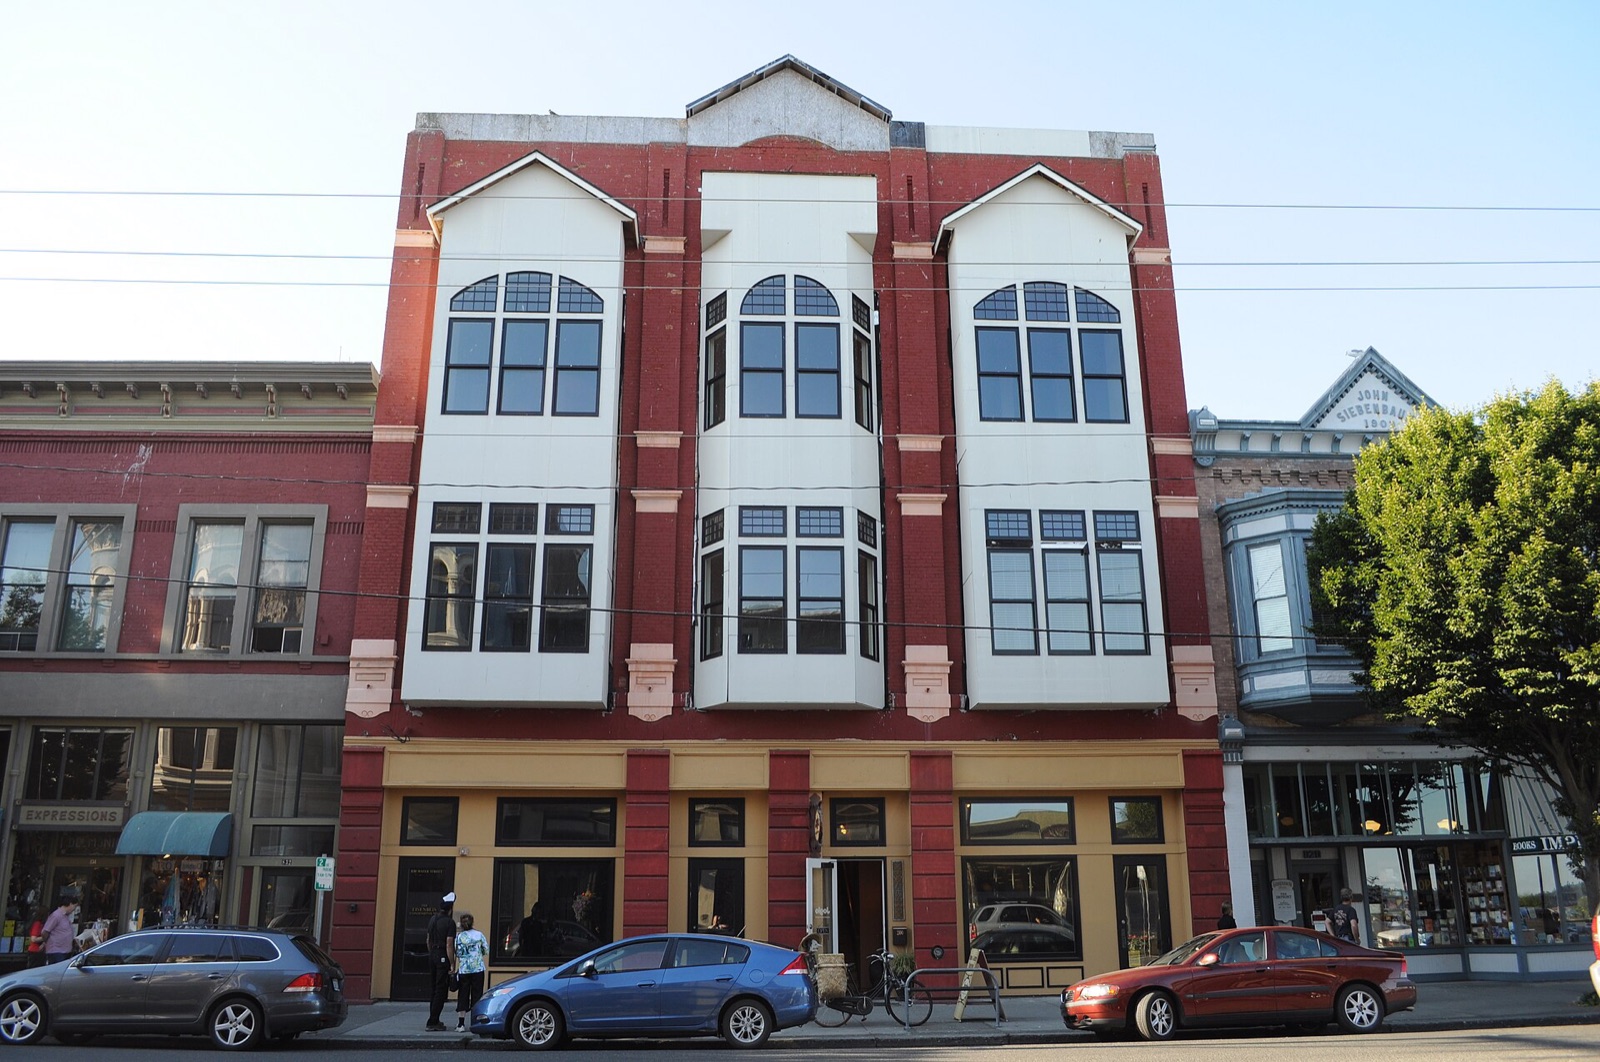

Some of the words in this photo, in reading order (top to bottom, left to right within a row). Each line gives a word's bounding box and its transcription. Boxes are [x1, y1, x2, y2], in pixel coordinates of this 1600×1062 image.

[1357, 389, 1388, 402] JOHN
[1336, 403, 1407, 423] SIEBENBAU
[25, 810, 118, 822] EXPRESSIONS
[1512, 840, 1537, 851] BOOKS
[1418, 879, 1446, 891] OPN
